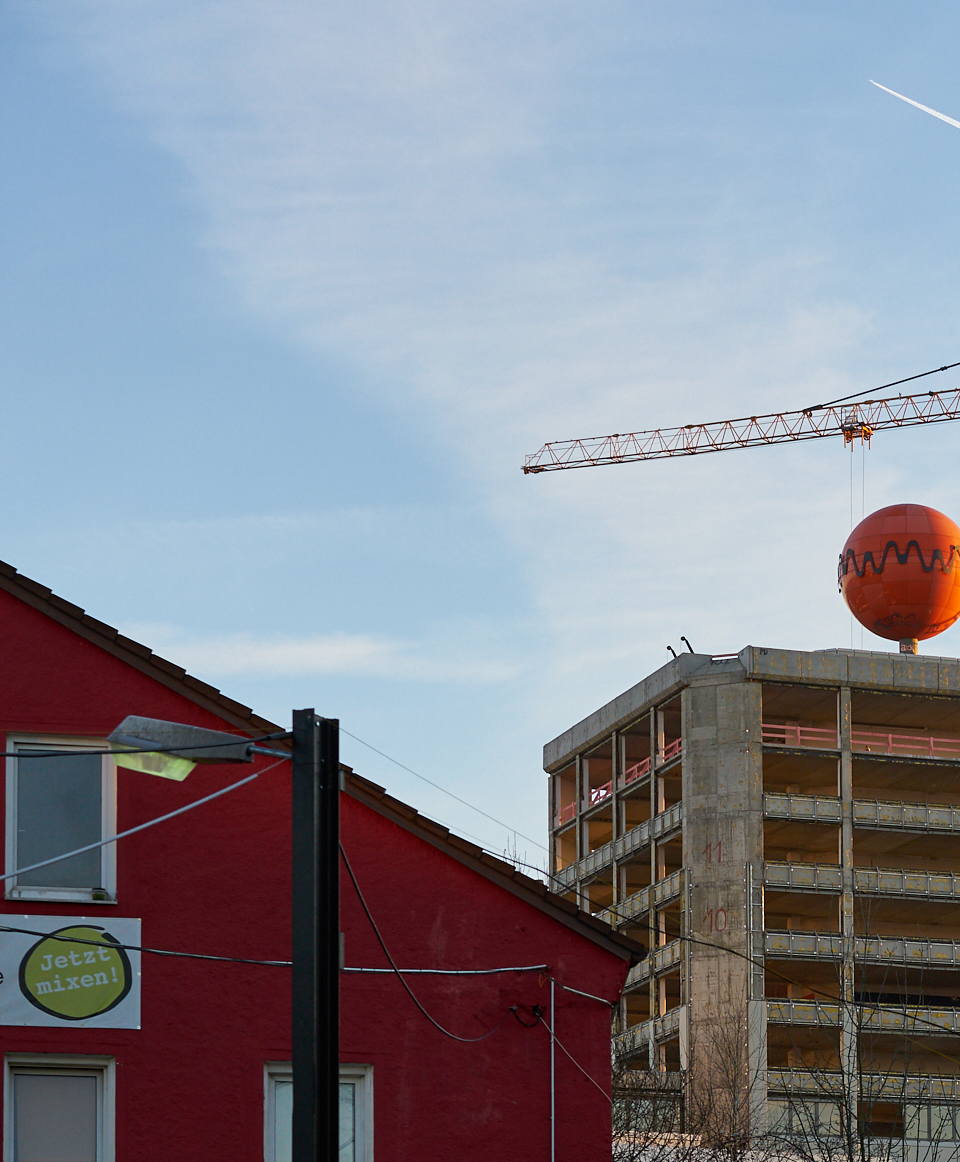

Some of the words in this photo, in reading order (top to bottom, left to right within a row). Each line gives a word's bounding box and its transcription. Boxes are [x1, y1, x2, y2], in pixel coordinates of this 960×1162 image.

[703, 841, 721, 863] 11
[703, 908, 726, 933] 10
[41, 946, 111, 971] Jetzt
[36, 967, 118, 994] mixen!
